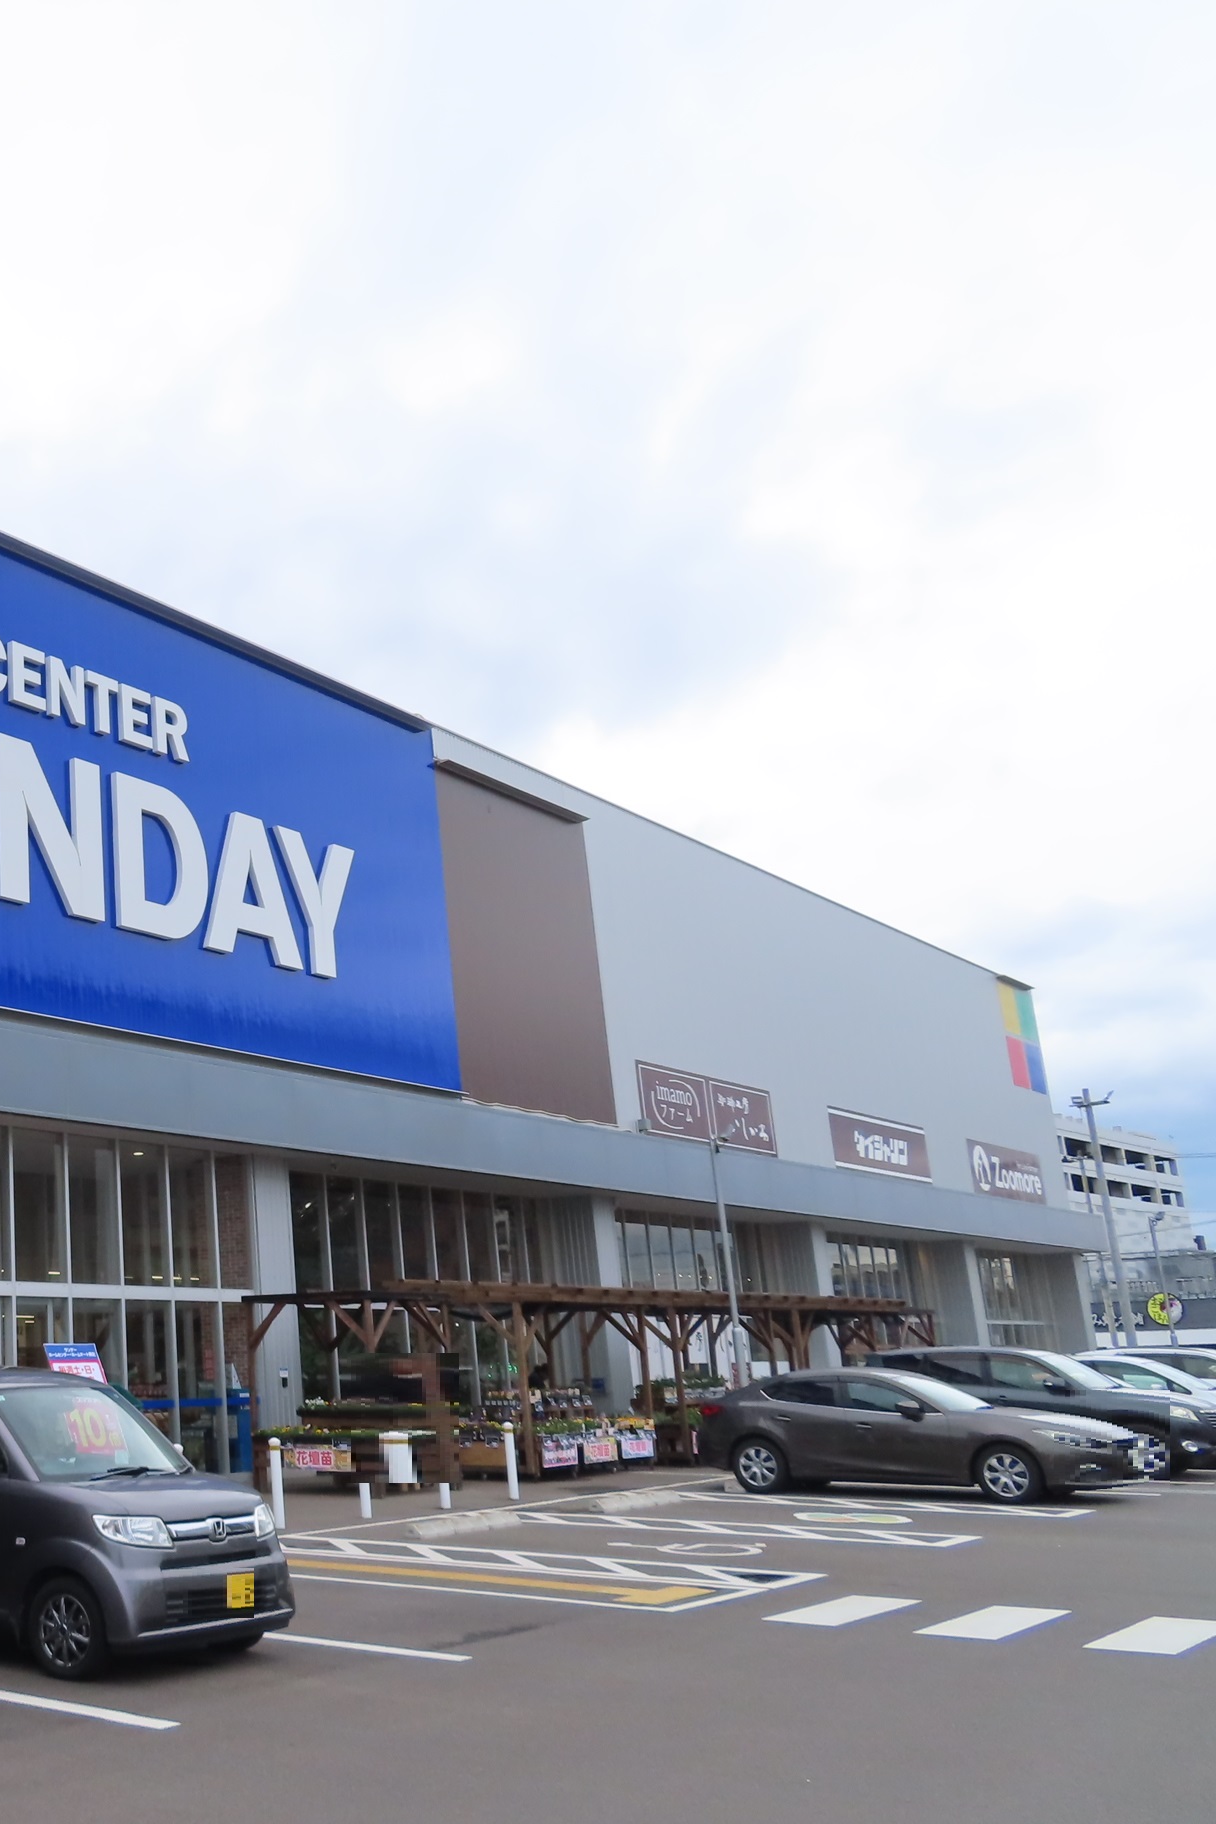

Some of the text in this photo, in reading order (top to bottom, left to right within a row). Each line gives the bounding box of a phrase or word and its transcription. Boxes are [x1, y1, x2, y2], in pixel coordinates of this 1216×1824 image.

[656, 1081, 693, 1106] imamo
[660, 1104, 694, 1124] ファーム
[991, 1156, 1042, 1195] Zoomore
[296, 1450, 333, 1466] 花壇苗
